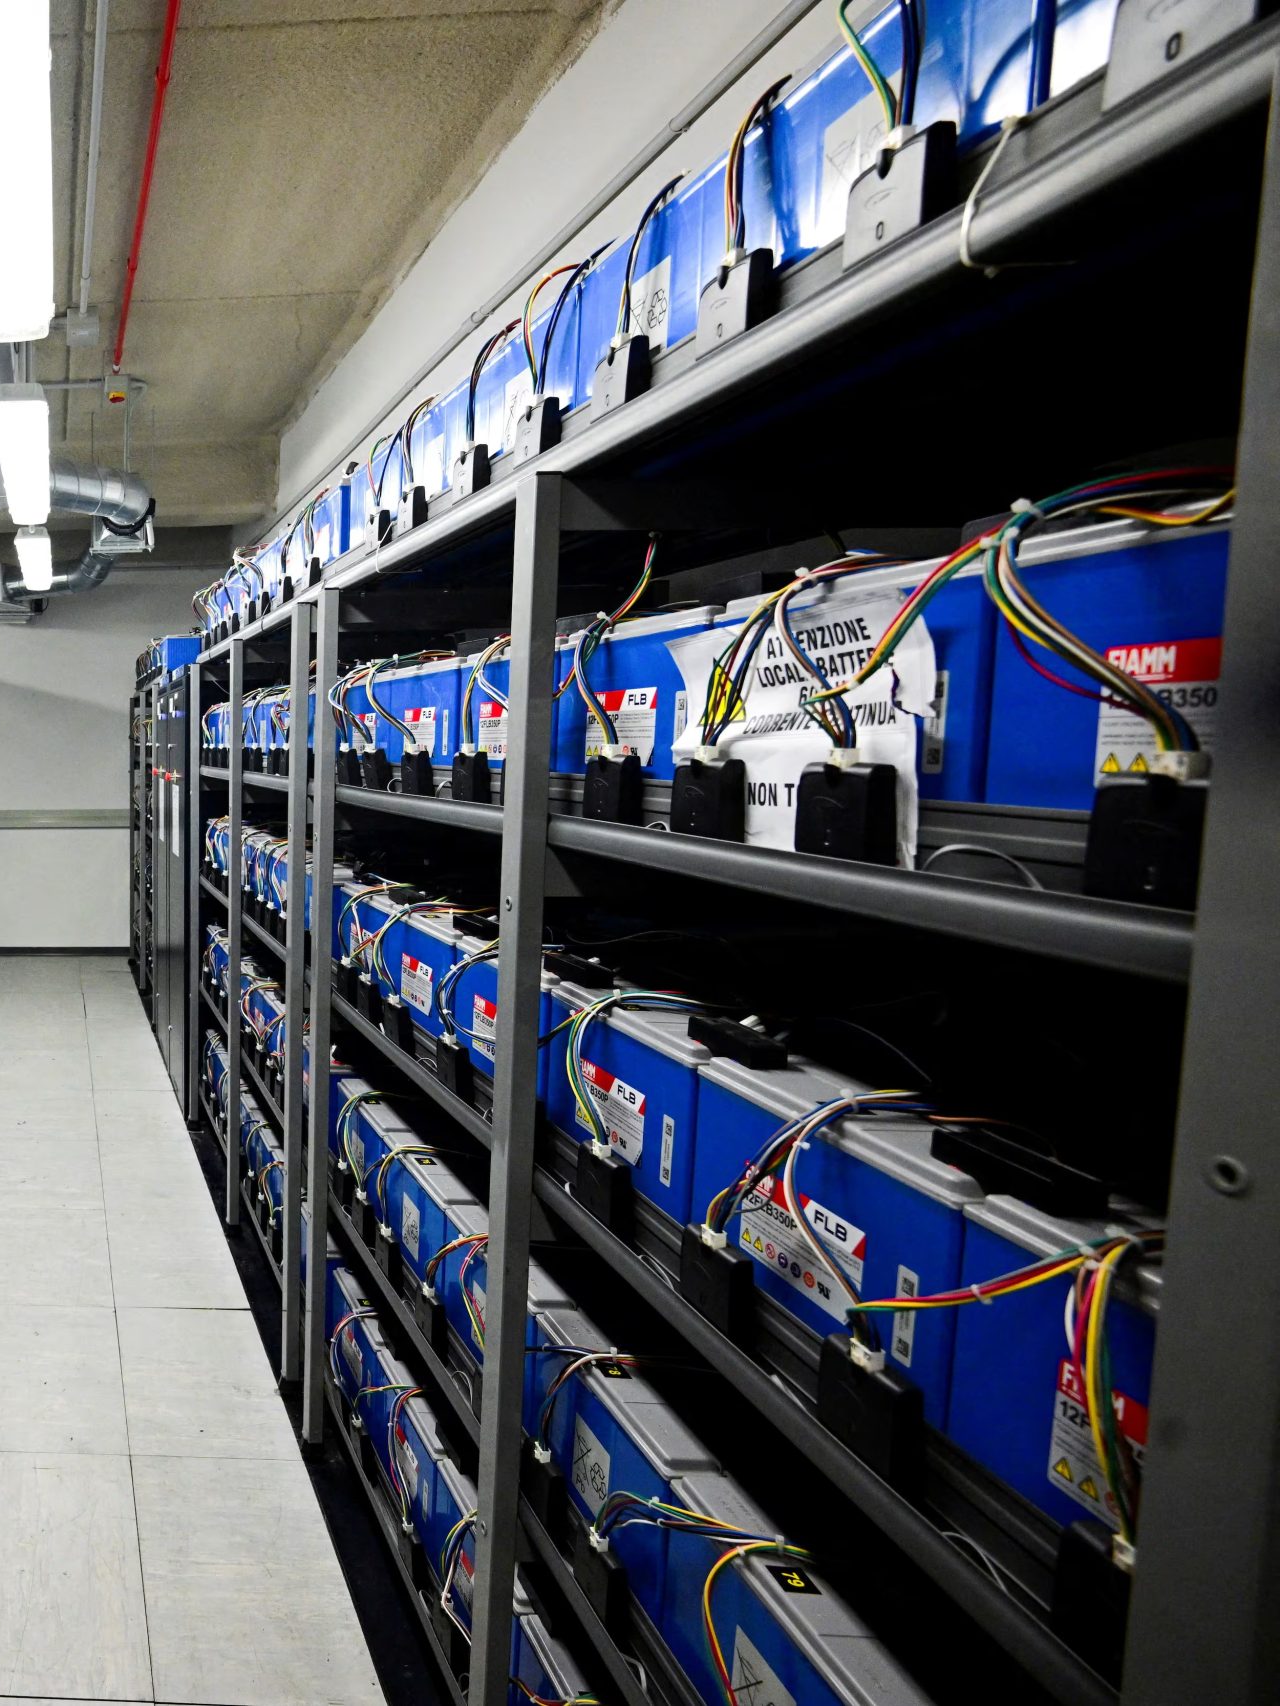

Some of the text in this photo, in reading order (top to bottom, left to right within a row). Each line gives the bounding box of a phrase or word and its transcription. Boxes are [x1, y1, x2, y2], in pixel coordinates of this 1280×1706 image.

[767, 617, 872, 660] ATENZIONE
[628, 693, 647, 706] FLB
[748, 783, 776, 805] NON
[617, 1084, 636, 1105] FLB
[814, 1209, 848, 1243] FLB
[780, 1572, 805, 1587] 79
